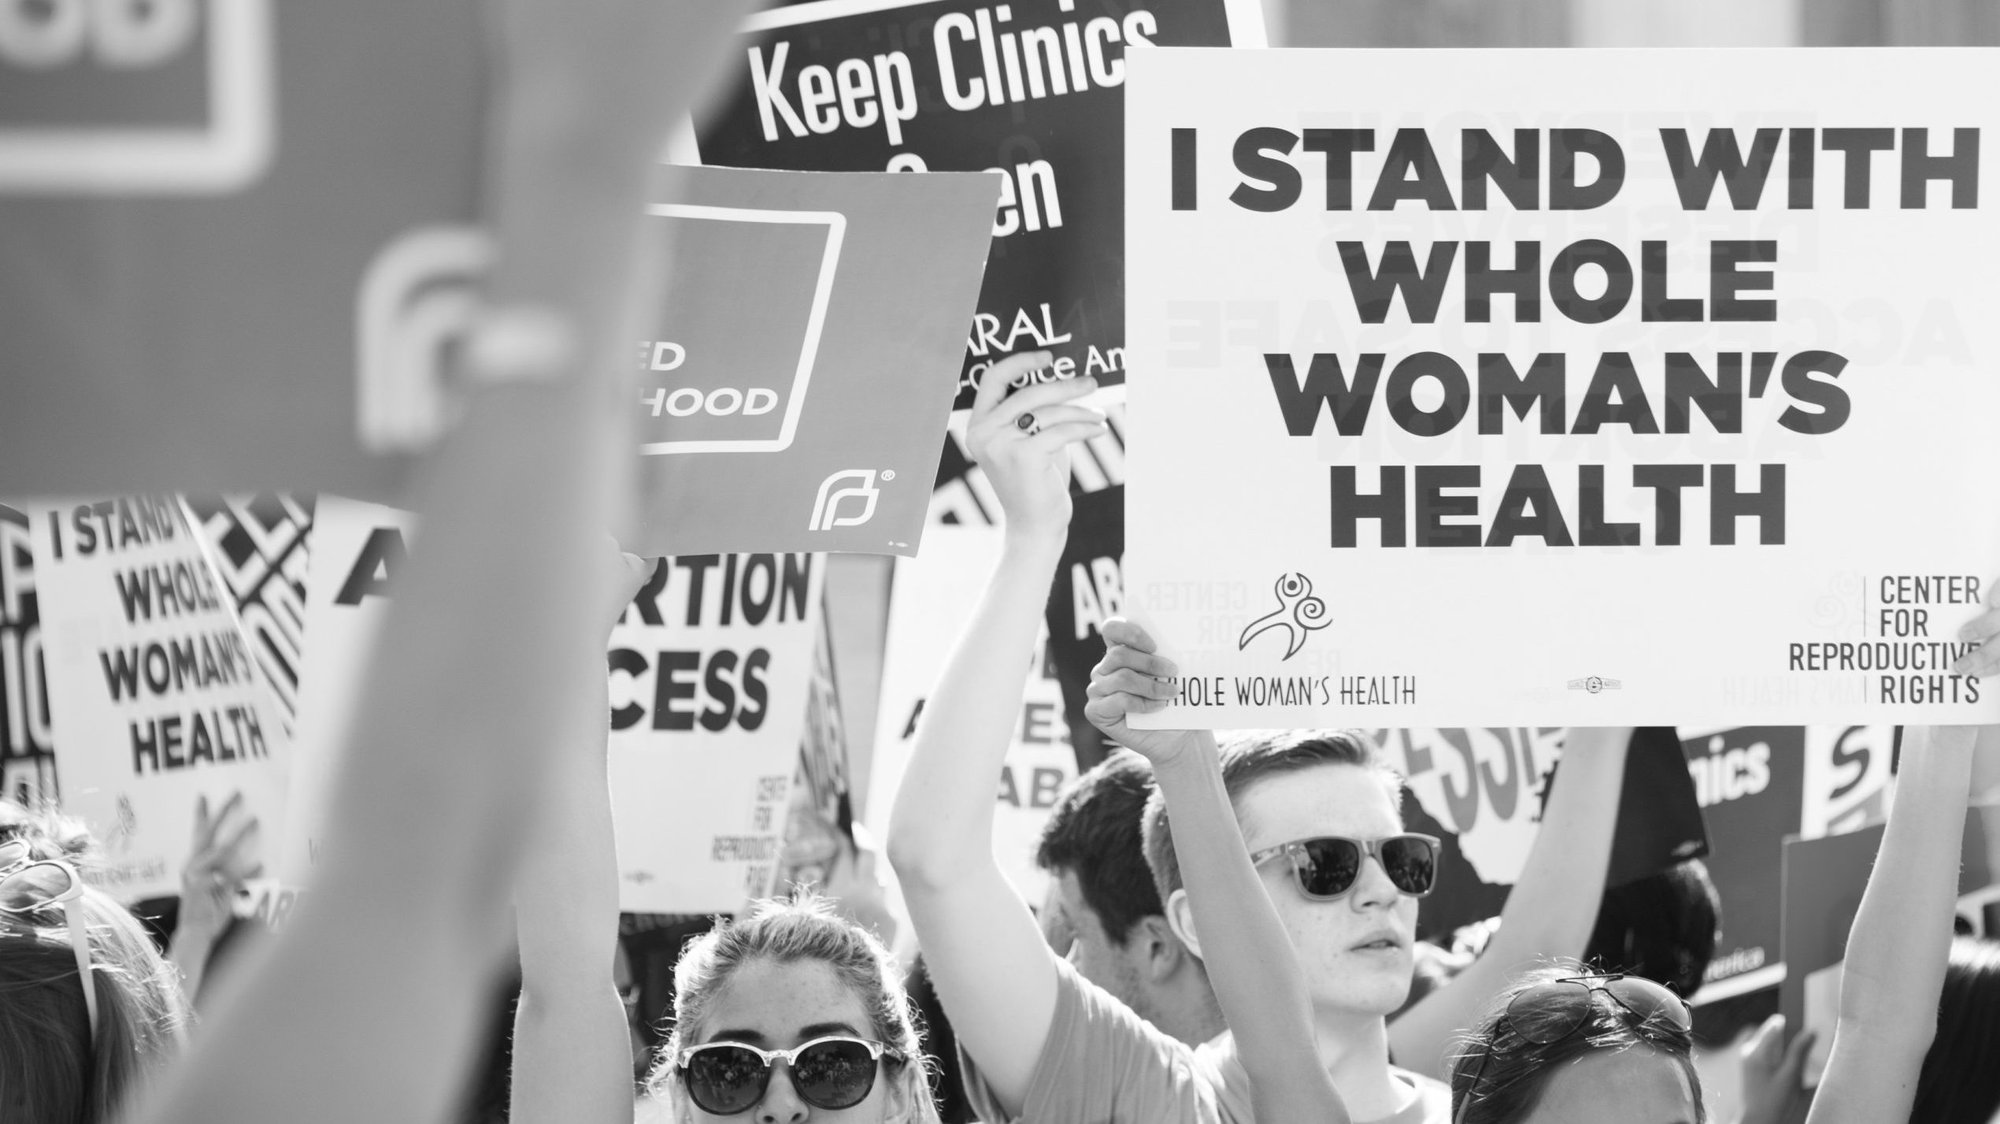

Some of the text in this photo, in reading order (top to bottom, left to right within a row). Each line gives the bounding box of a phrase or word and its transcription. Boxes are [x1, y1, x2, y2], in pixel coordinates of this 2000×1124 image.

[747, 0, 1157, 146] Keep Clinics
[1171, 126, 1980, 213] I STAND WITH
[1336, 238, 1778, 325] WHOLE
[1263, 350, 1851, 437] WOMAN'S
[1330, 463, 1786, 549] HEALTH
[115, 560, 219, 625] WHOLE
[1880, 575, 1980, 604] CENTER
[1880, 609, 1928, 637] FOR
[1154, 675, 1415, 707] HOLE WOMAN'S HEALTH
[1880, 675, 1980, 704] RIGHTS
[130, 706, 268, 776] HEALTH
